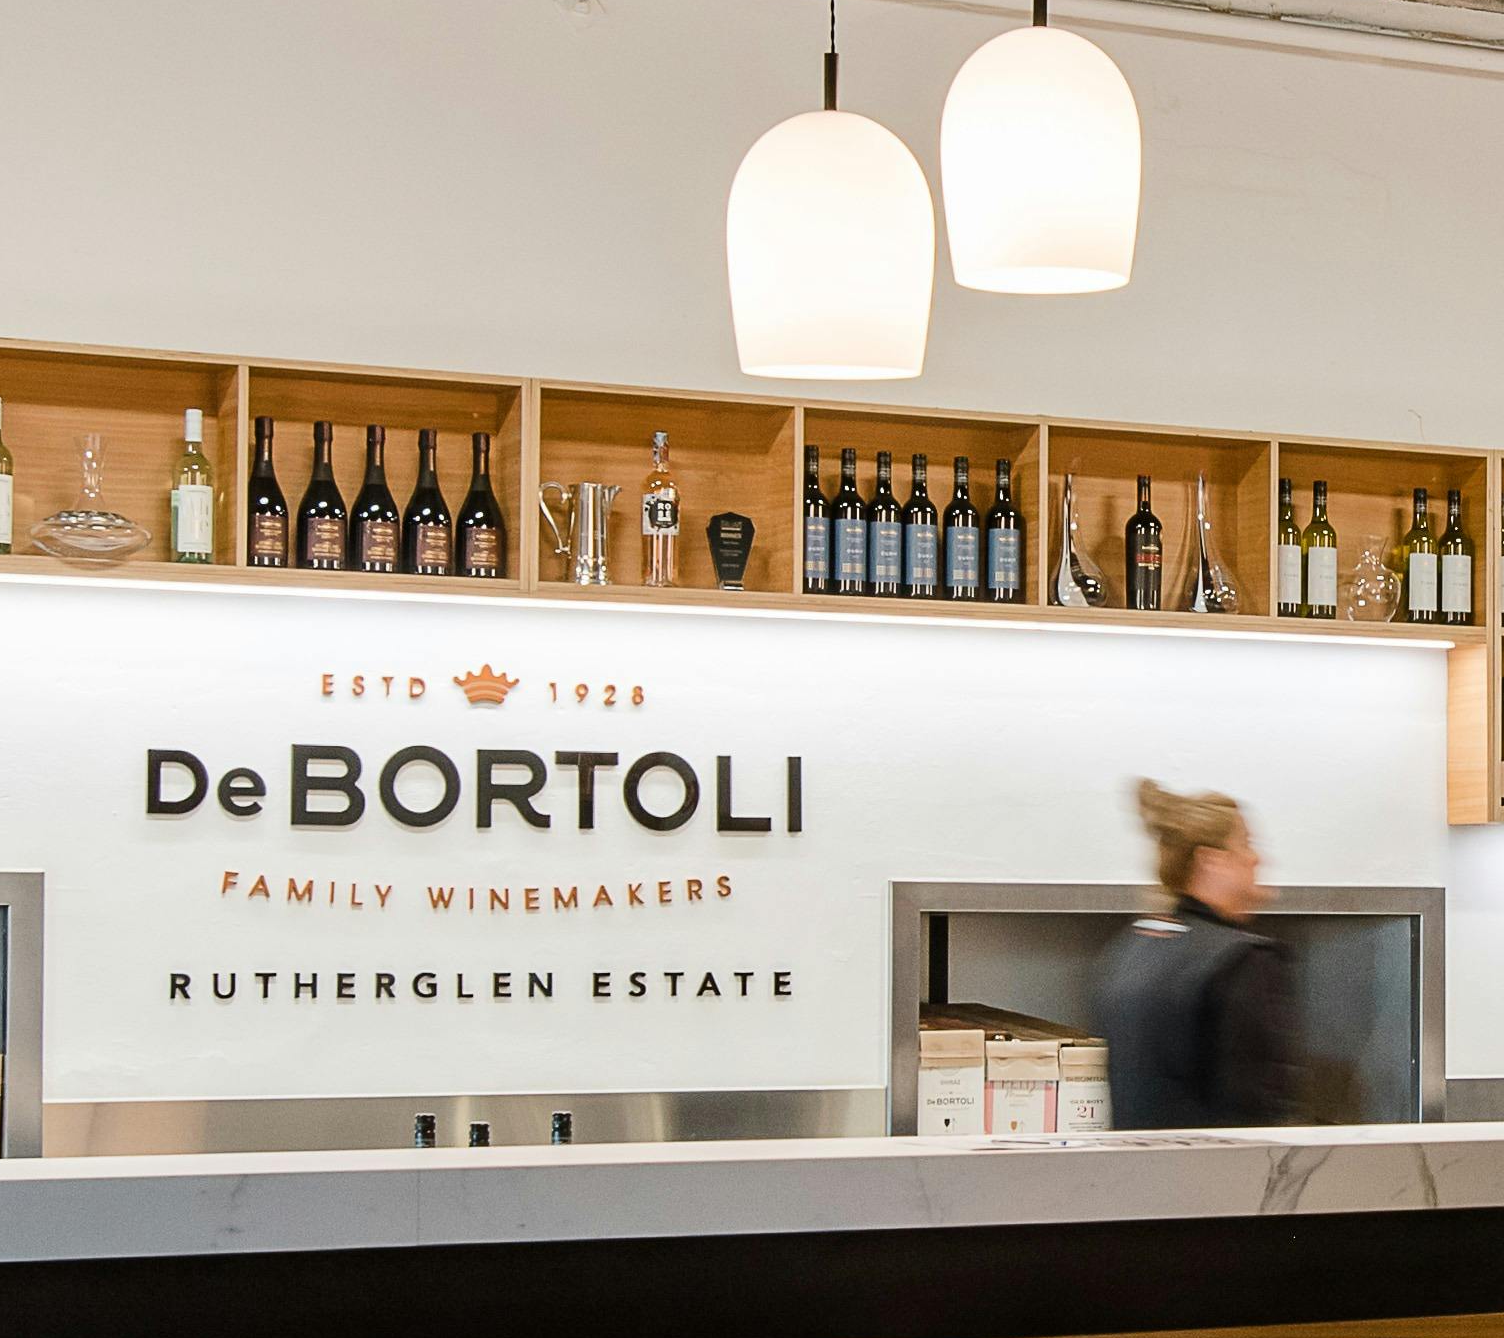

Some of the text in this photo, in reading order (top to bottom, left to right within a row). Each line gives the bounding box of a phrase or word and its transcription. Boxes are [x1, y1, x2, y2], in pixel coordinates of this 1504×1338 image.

[321, 673, 646, 708] ESTD 1928
[221, 870, 735, 912] FAMILY WINEMAKERS
[169, 970, 794, 1001] RUTHERGLEN ESTATE
[1076, 1107, 1096, 1119] 21
